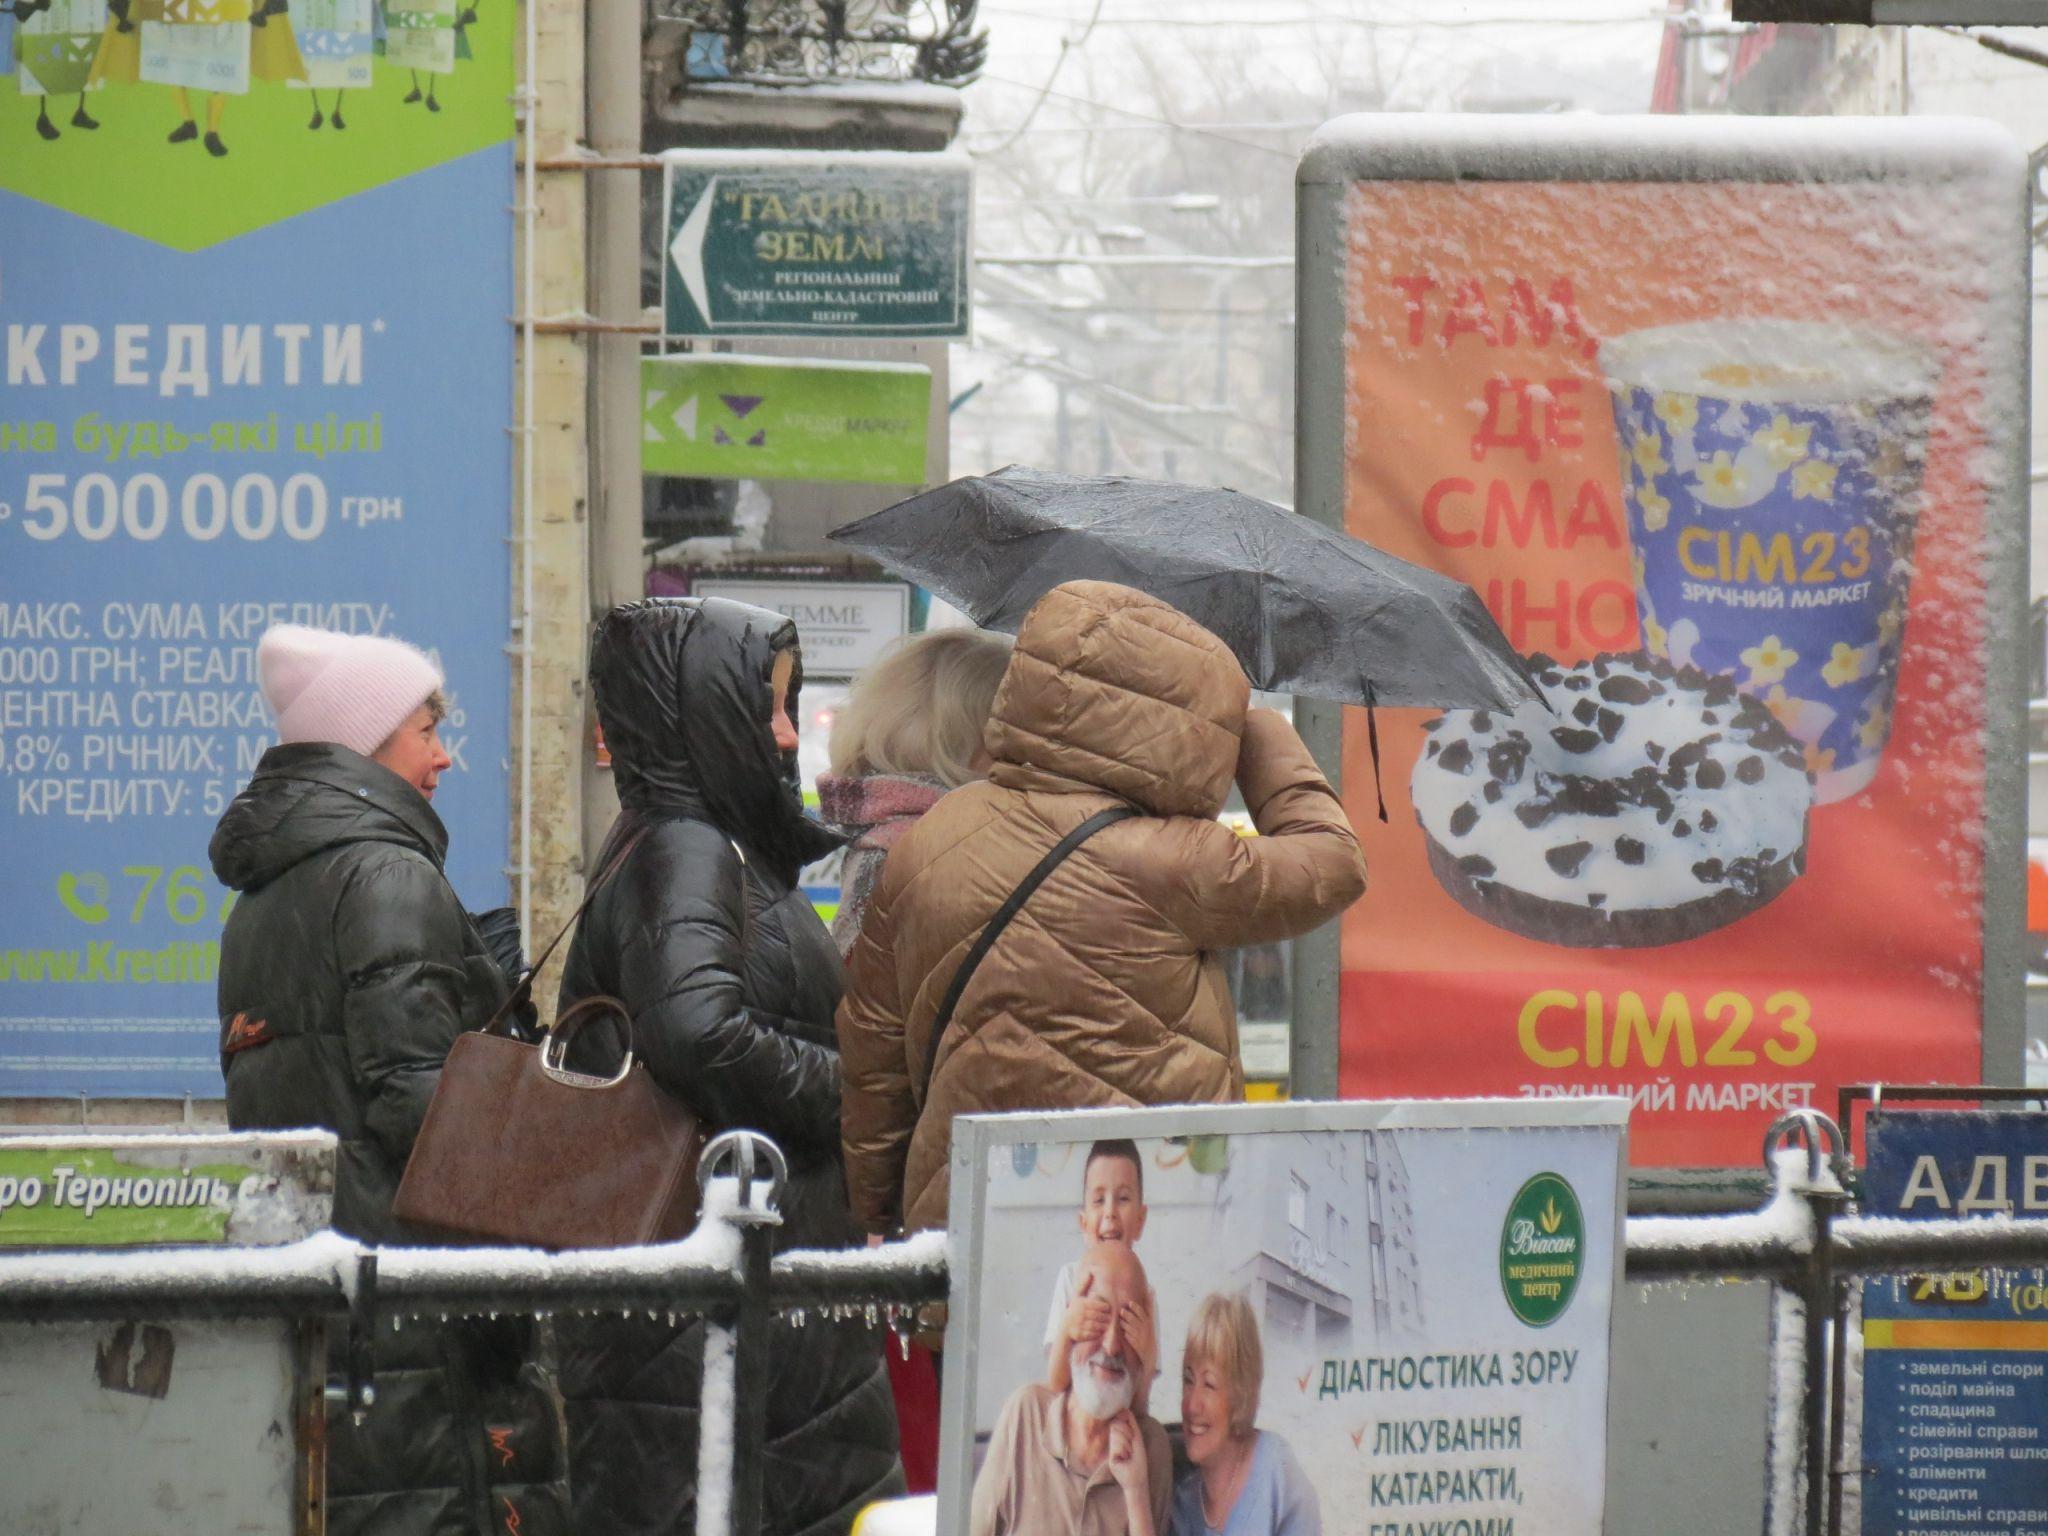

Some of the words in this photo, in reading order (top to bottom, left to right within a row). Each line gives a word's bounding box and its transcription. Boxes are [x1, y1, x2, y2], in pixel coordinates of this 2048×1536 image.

[774, 270, 901, 286] РЕГІОНАЛЬНИЙ
[812, 310, 859, 323] ЦЕНТР
[1392, 276, 1598, 359] ТАМ,
[0, 421, 57, 453] на
[73, 410, 278, 462] будь-які
[294, 411, 383, 460] цілі
[1470, 378, 1585, 463] ДЕ
[340, 496, 403, 528] грн
[1421, 476, 1622, 550] СМА
[1677, 525, 1872, 584] СІМ23
[1682, 580, 1785, 609] ЗРУЧНИЙ
[1791, 580, 1872, 609] МАРКЕТ
[102, 602, 209, 640] СУМА
[70, 646, 147, 689] ГРН;
[0, 690, 121, 733] ЕНТНА
[82, 734, 225, 776] РІЧНИХ;
[18, 779, 192, 823] КРЕДИТУ:
[203, 780, 225, 816] 5
[1517, 988, 1818, 1069] СІМ23
[1685, 1082, 1816, 1112] МАРКЕТ
[52, 1167, 230, 1217] Тернопіль
[1508, 1261, 1575, 1281] медичний
[1522, 1282, 1562, 1301] центр
[1318, 1354, 1505, 1401] ДІАГНОСТИКА
[1510, 1348, 1580, 1386] ЗОРУ
[1909, 1361, 1986, 1374] земельні
[1992, 1364, 2043, 1377] спори
[1909, 1380, 1956, 1396] поділ
[1962, 1380, 2014, 1395] майна
[1909, 1403, 1994, 1418] спадщина
[1372, 1414, 1523, 1456] ЛІКУВАННЯ
[1909, 1422, 1970, 1437] сімейні
[1976, 1426, 2037, 1440] справи
[1908, 1443, 2004, 1460] розірвання
[1370, 1466, 1524, 1507] КАТАРАКТИ,
[1908, 1464, 1985, 1478] аліменти
[1908, 1487, 1977, 1501] кредити
[1907, 1505, 1980, 1521] цивільні
[1986, 1509, 2048, 1523] справи
